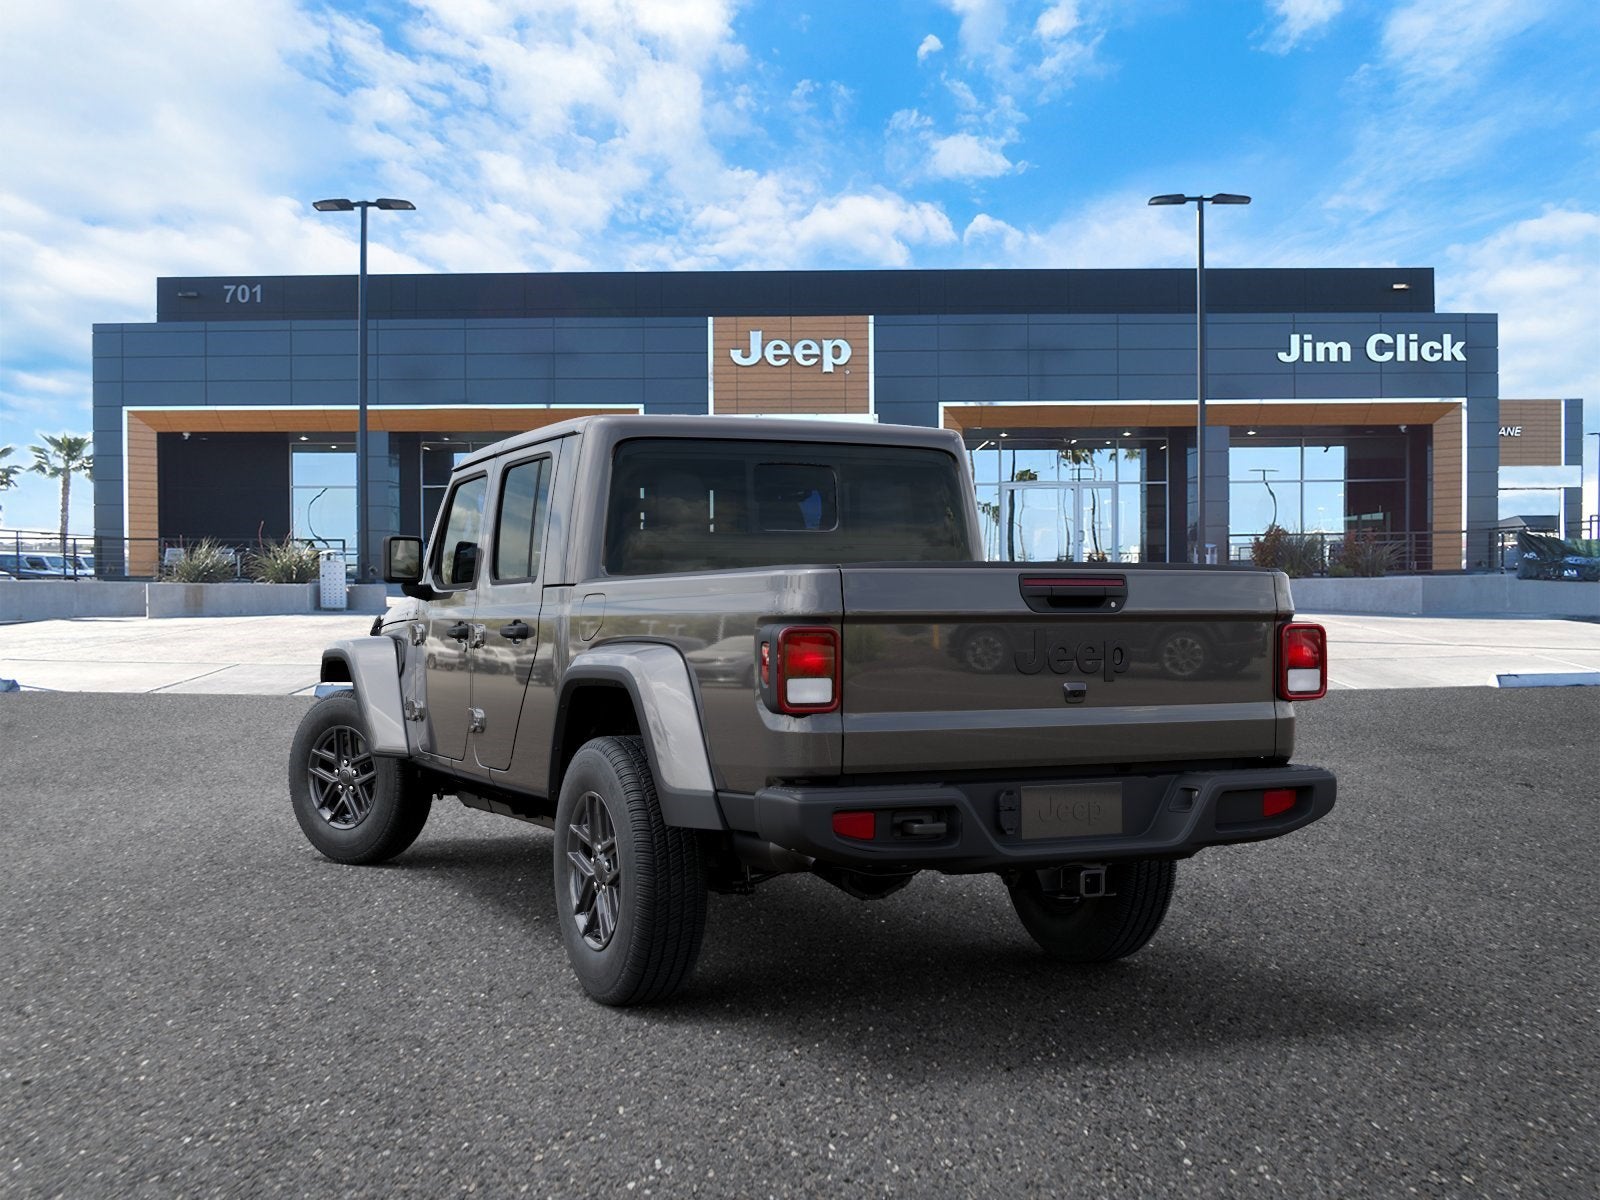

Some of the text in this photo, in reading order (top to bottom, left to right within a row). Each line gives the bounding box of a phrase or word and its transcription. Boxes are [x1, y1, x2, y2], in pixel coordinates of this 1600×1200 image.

[223, 284, 262, 304] 701
[729, 330, 852, 373] Jeep
[1277, 333, 1467, 362] Jim Click
[1014, 629, 1129, 682] Jeep
[1036, 793, 1103, 826] Jeep
